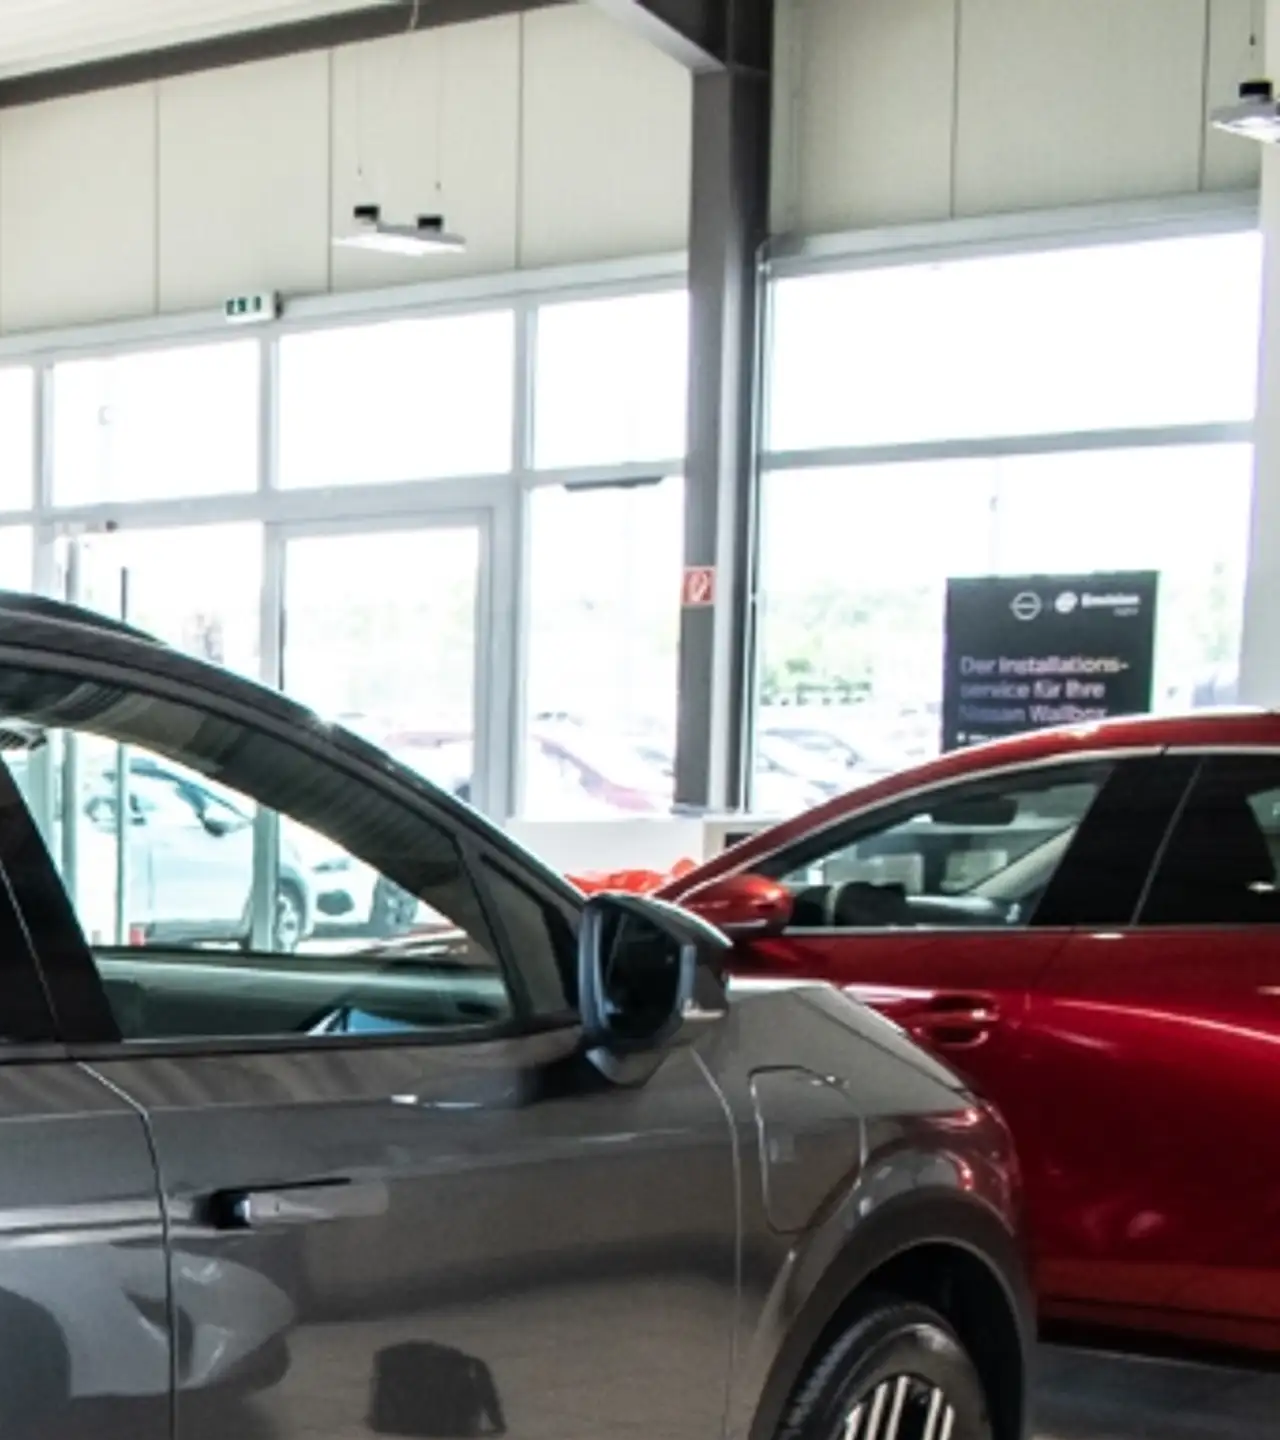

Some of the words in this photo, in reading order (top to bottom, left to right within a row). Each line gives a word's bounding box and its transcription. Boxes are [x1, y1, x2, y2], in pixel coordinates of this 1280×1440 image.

[960, 656, 997, 675] Der
[999, 655, 1129, 675] Installations-
[960, 681, 1029, 699] service
[1033, 680, 1061, 699] für
[1065, 680, 1106, 699] Ihre
